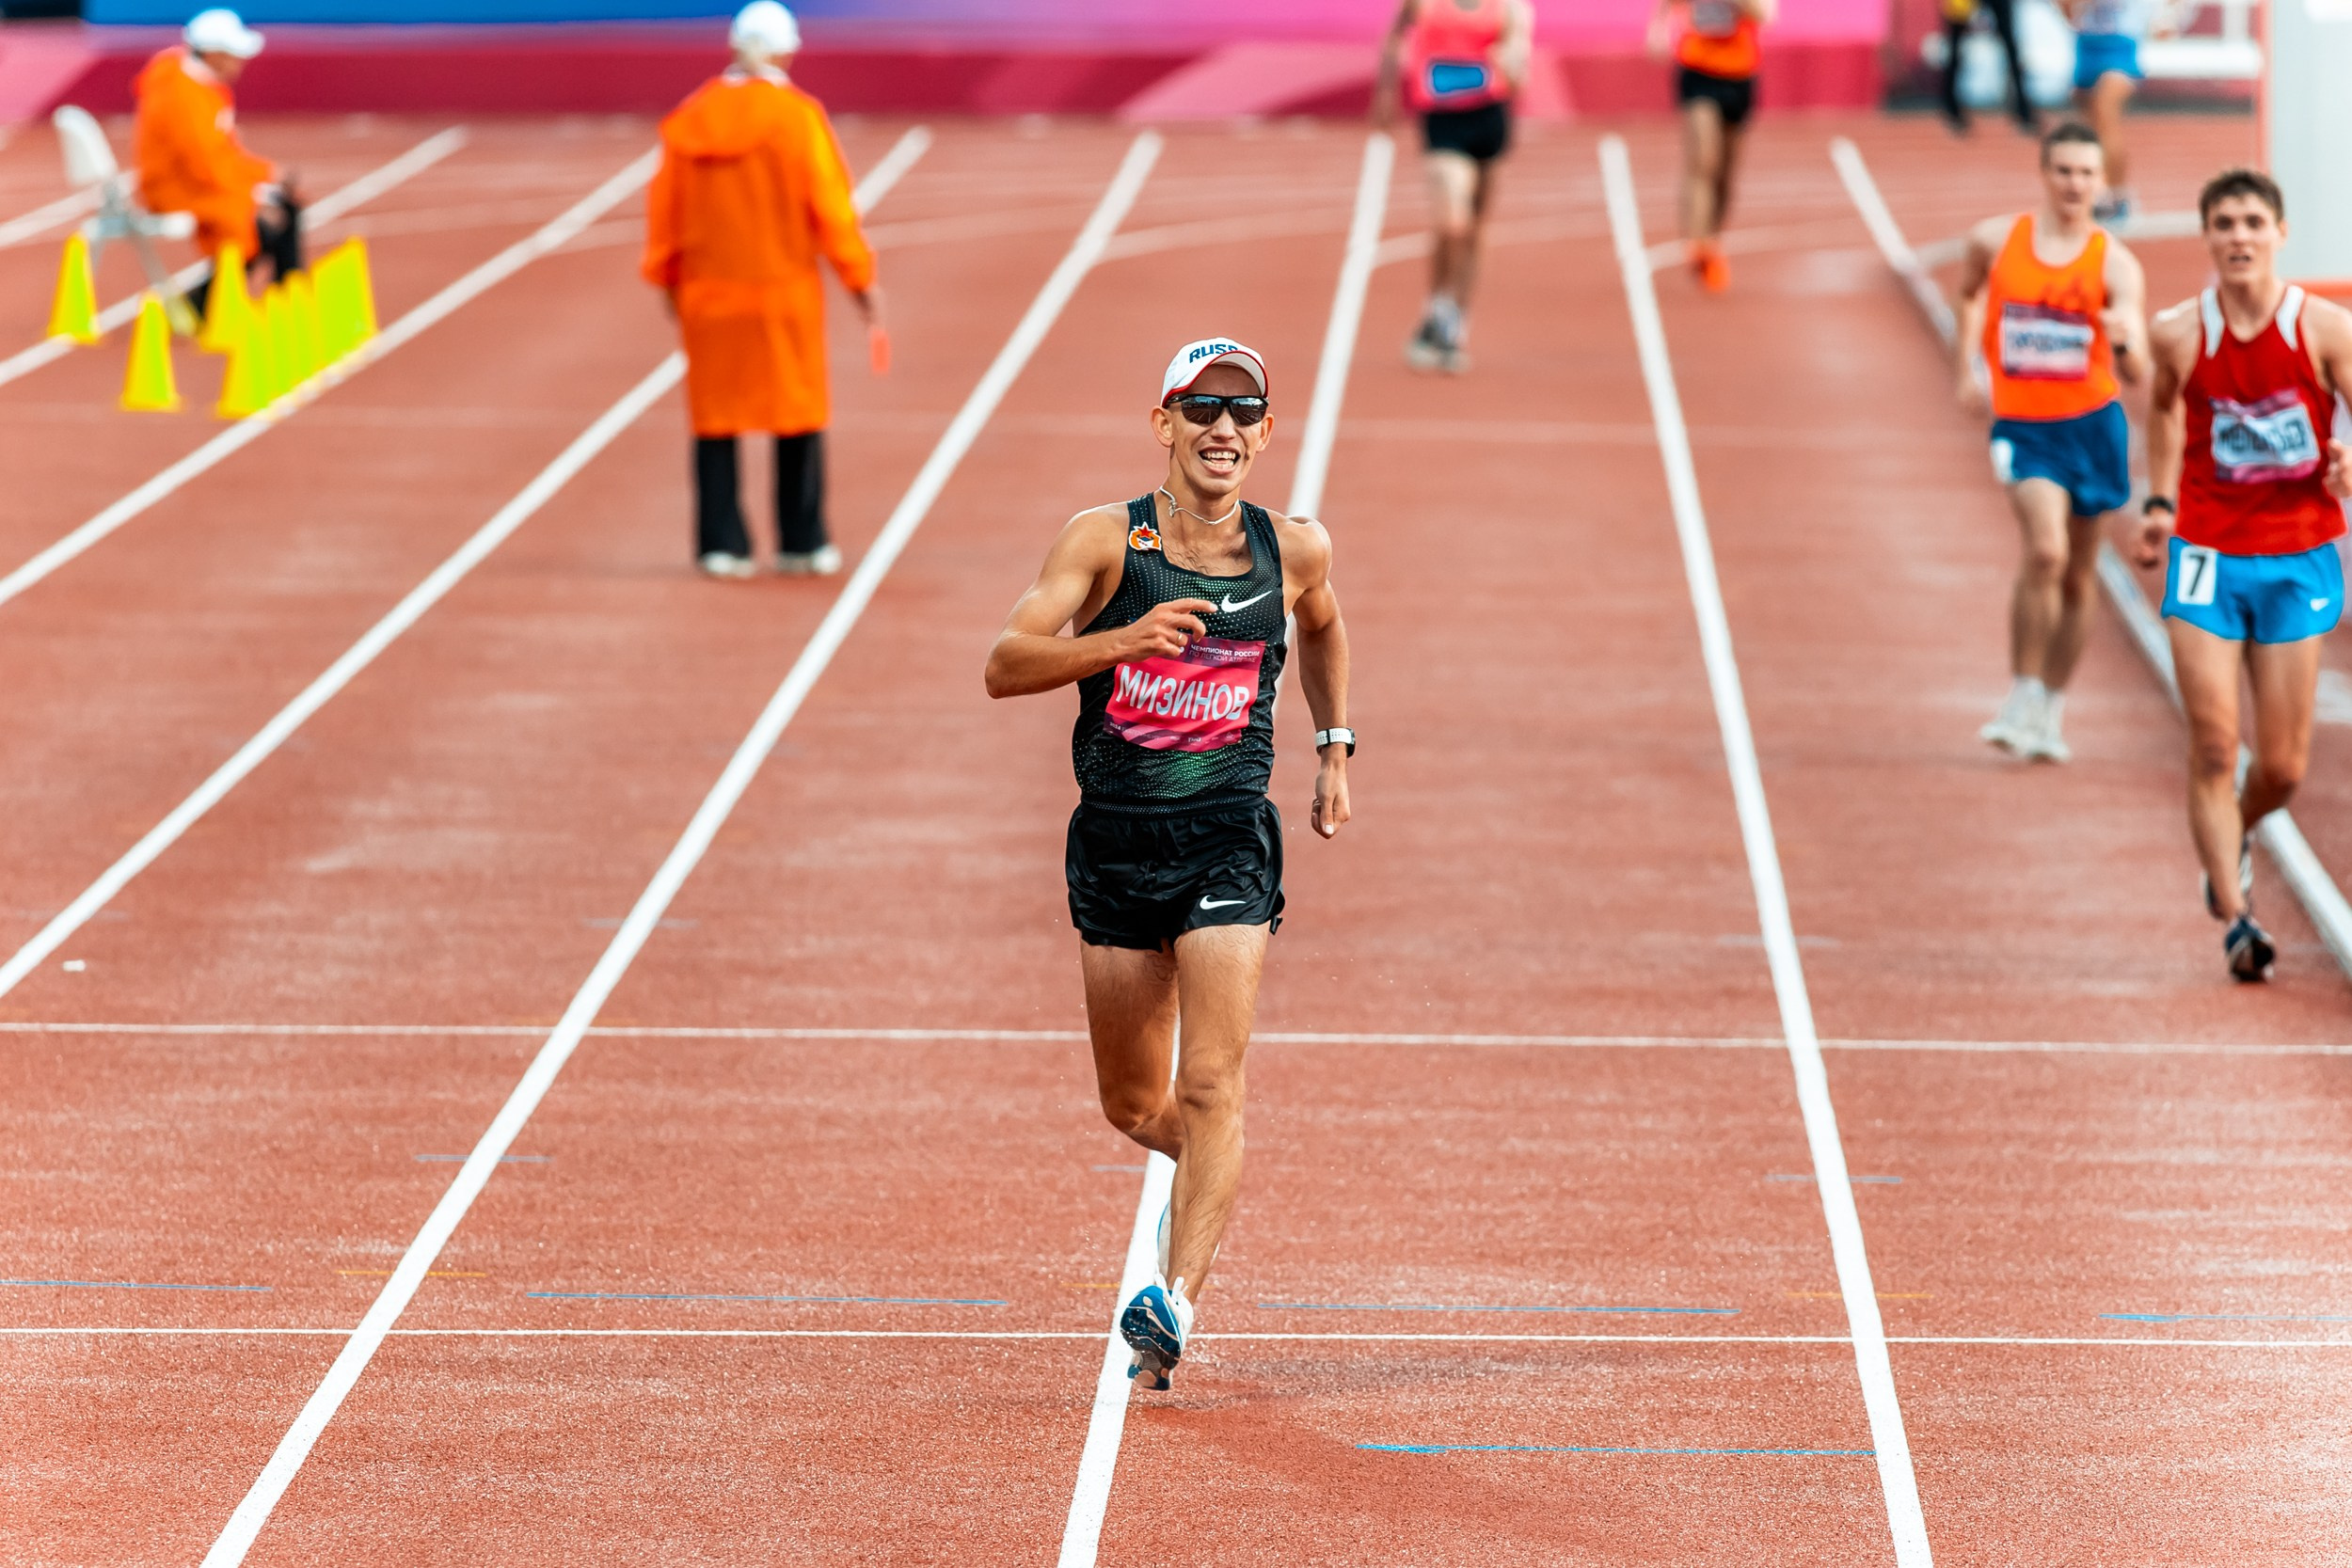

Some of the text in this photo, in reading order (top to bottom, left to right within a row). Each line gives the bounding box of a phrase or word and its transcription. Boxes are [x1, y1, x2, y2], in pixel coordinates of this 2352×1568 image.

[2189, 554, 2206, 596] 7
[1190, 644, 1232, 657] ЧЕМПИОНАТ
[1116, 665, 1249, 721] МИЗИНОВ
